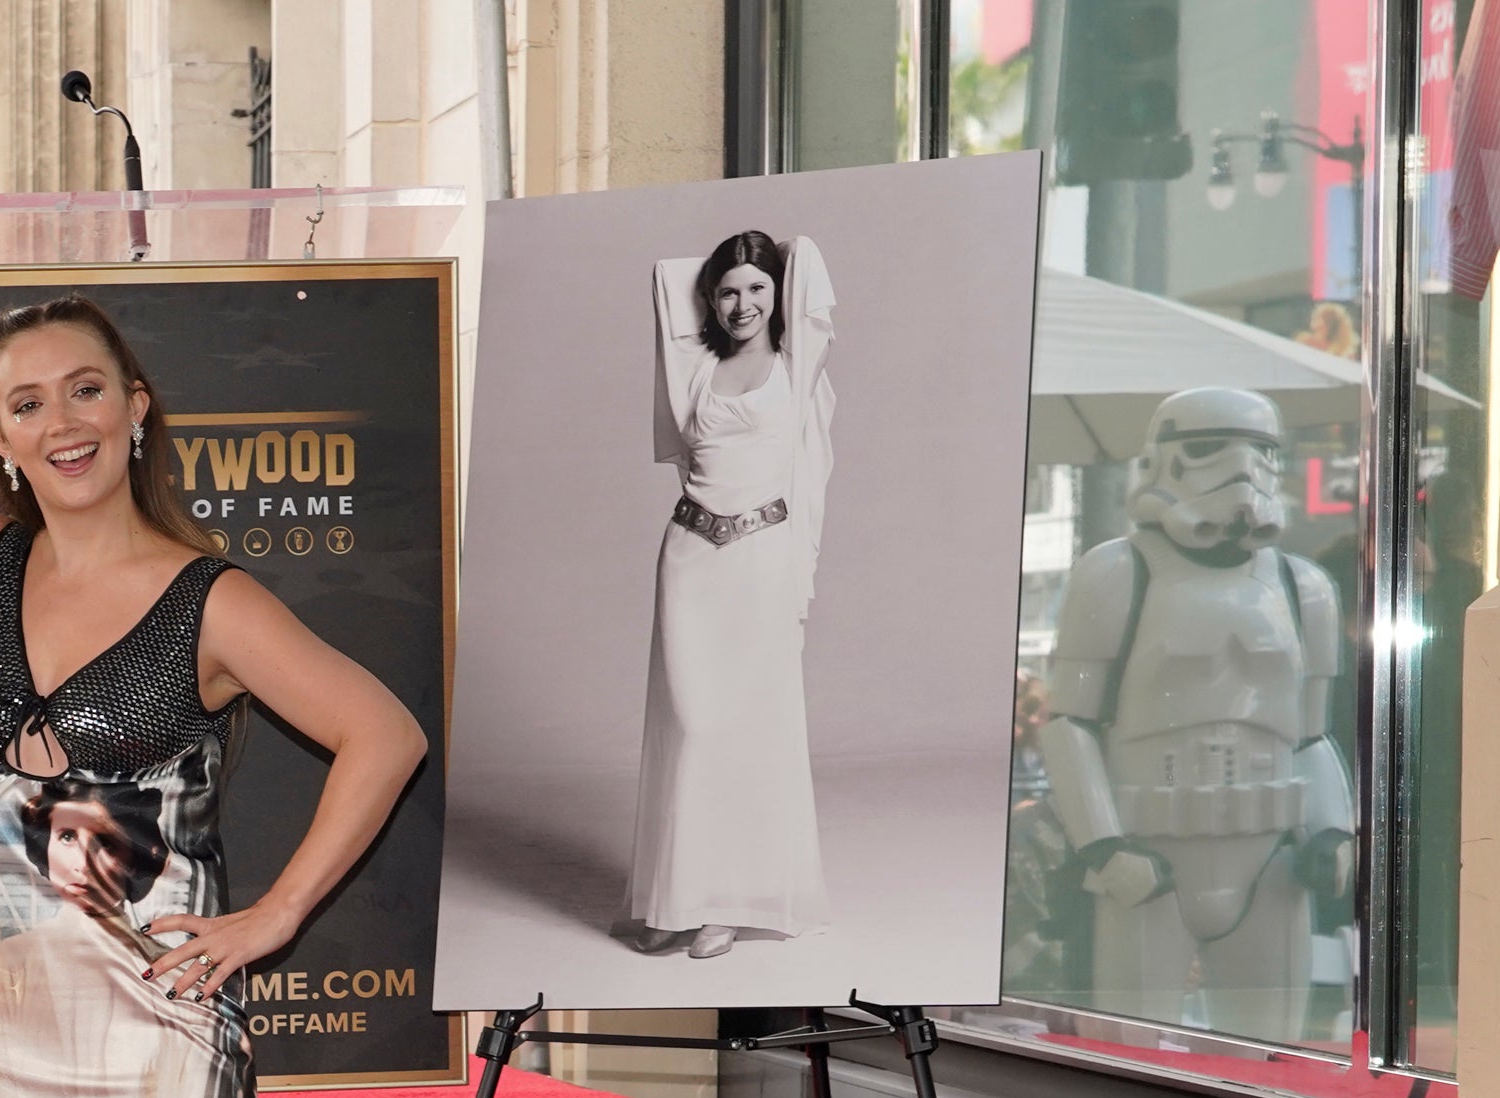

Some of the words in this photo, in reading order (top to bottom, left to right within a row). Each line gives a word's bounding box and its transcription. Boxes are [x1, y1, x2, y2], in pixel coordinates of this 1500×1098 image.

[168, 430, 355, 491] YWOOD
[192, 499, 235, 519] OF
[259, 496, 353, 516] FAME
[245, 969, 415, 1002] ME.COM
[250, 1012, 366, 1035] OFFAME
